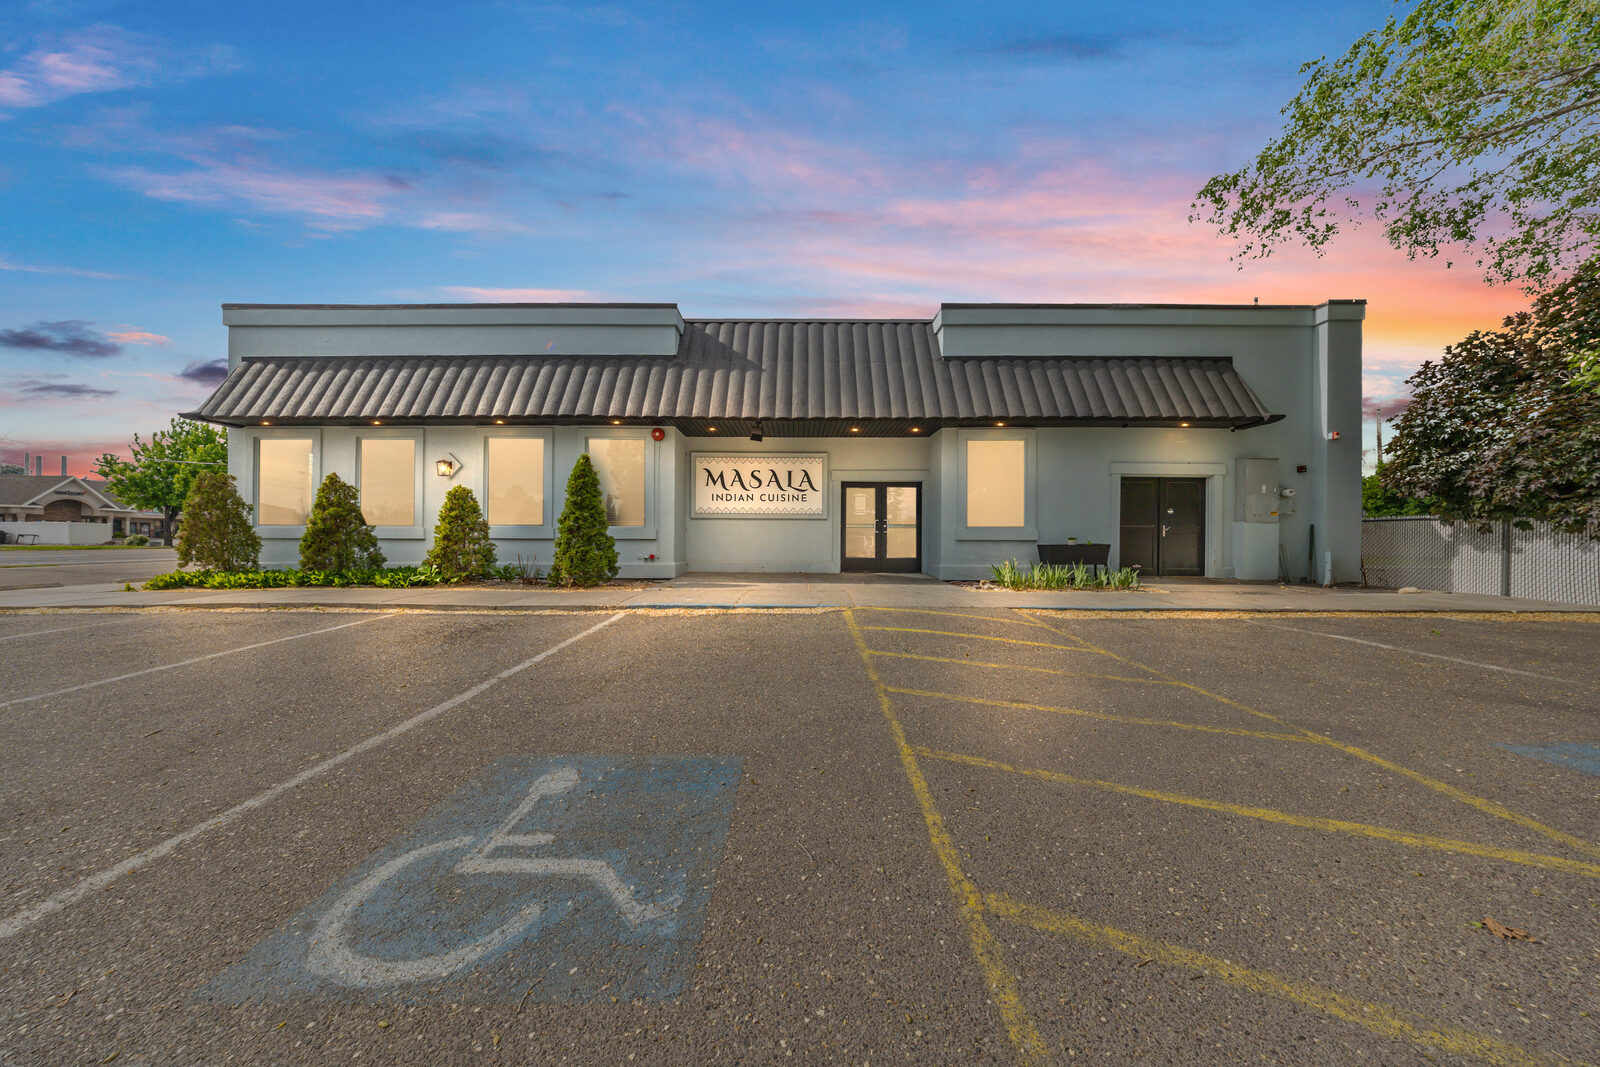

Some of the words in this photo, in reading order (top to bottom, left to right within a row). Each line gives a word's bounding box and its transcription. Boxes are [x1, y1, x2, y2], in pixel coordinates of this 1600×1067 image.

[703, 468, 820, 492] MASALA
[711, 493, 754, 502] INDIAN
[759, 493, 807, 502] CUISINE
